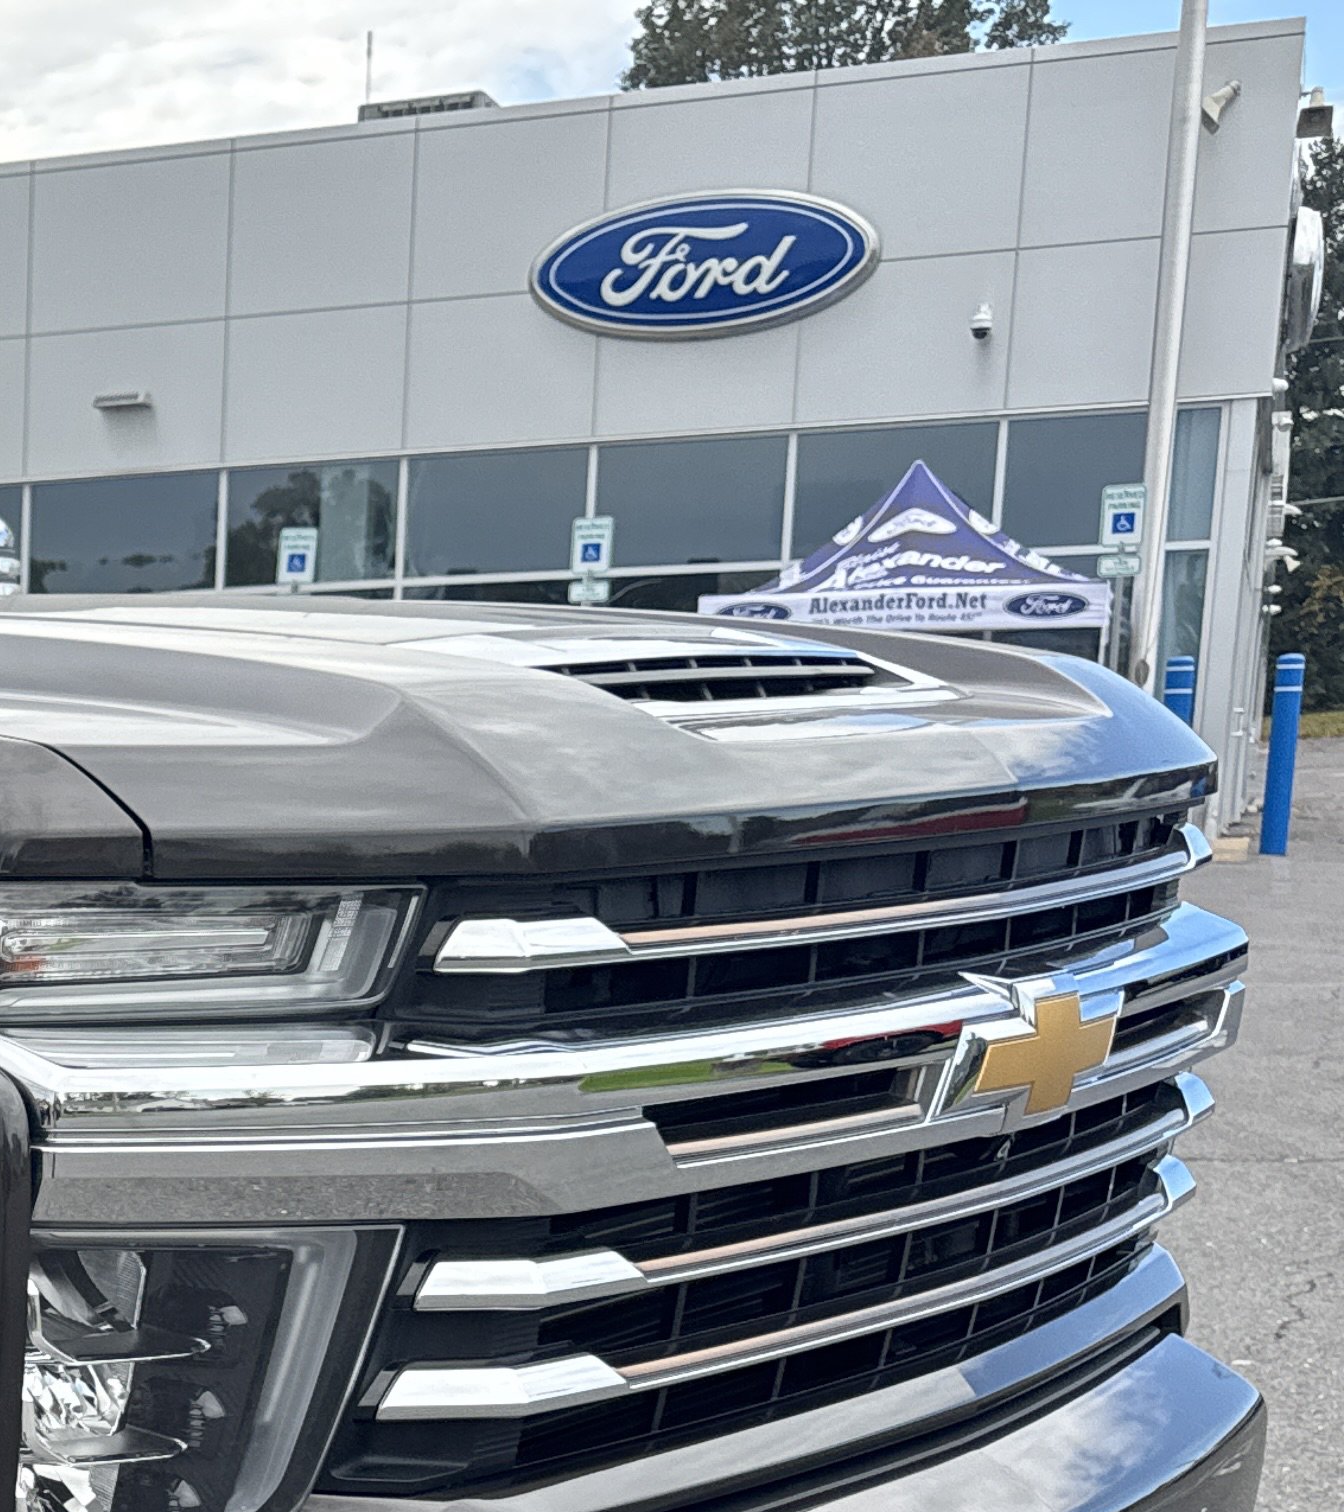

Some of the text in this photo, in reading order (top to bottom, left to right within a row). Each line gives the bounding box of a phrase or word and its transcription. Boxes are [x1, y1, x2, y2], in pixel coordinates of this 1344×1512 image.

[601, 222, 797, 306] Ford
[809, 592, 987, 614] AlexanderFord.Net
[1020, 595, 1072, 615] Ford
